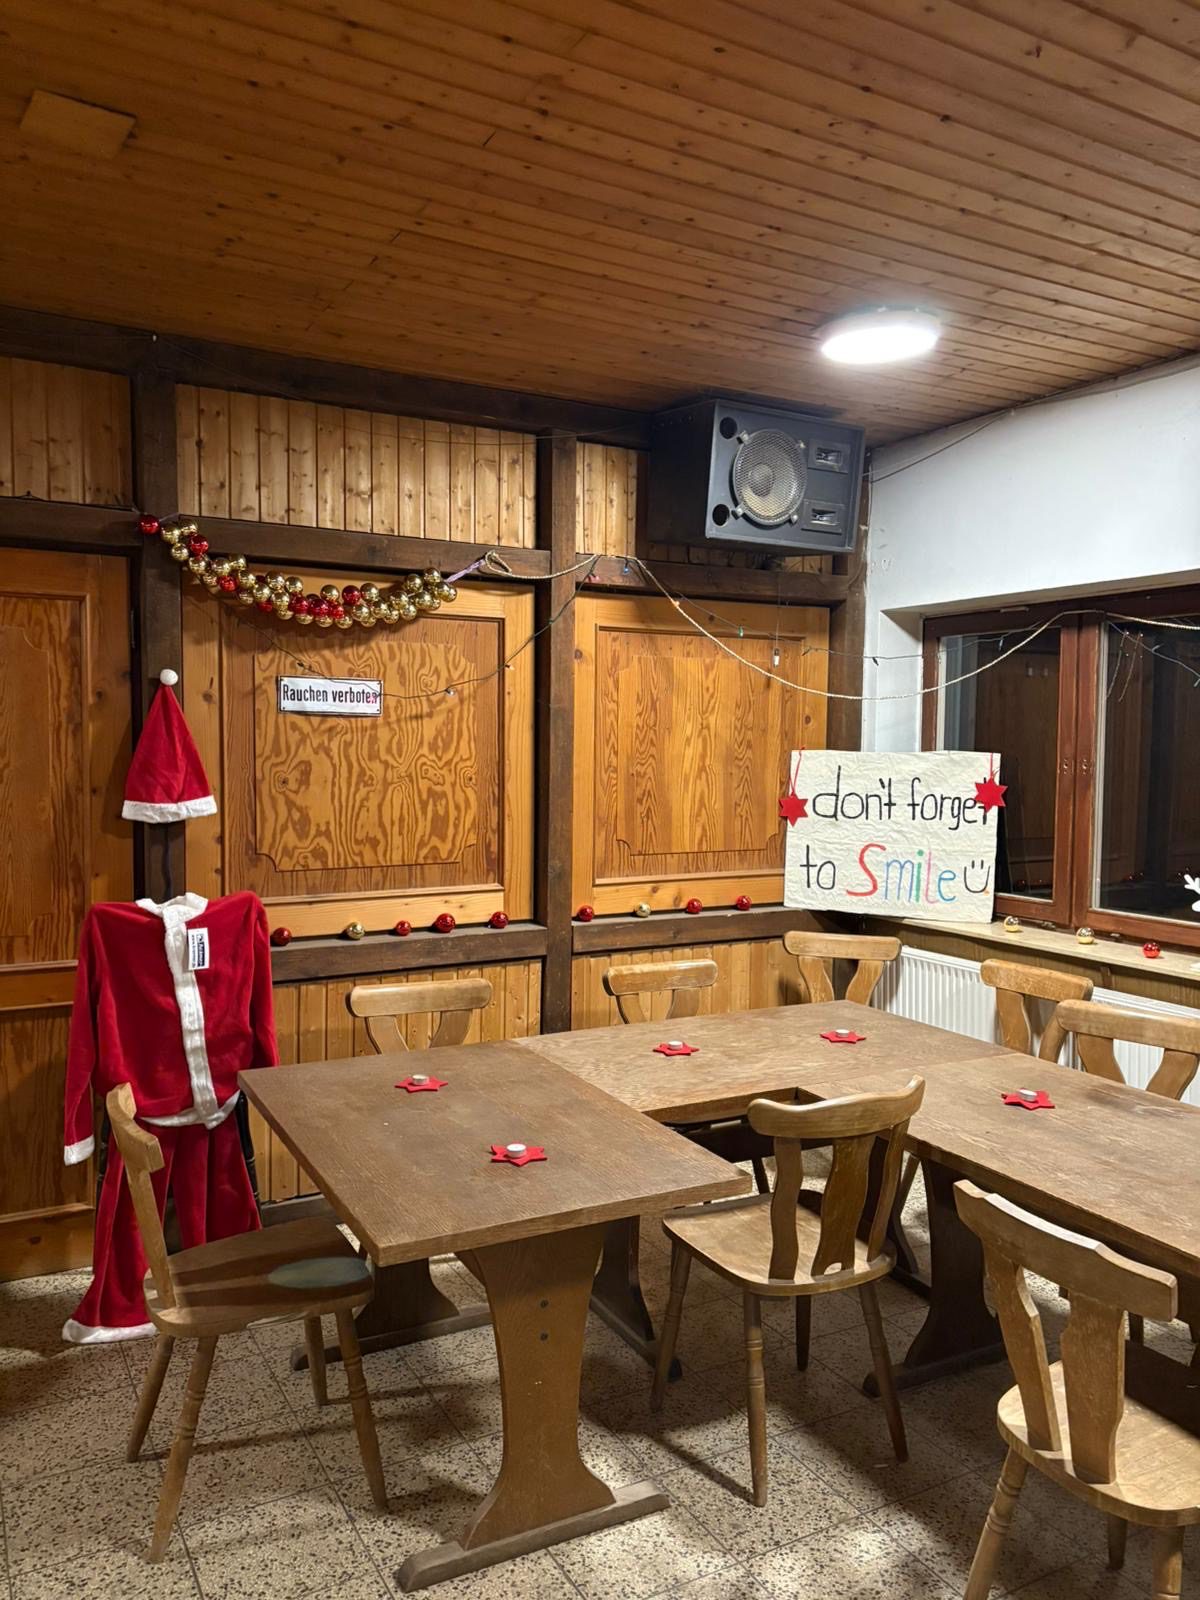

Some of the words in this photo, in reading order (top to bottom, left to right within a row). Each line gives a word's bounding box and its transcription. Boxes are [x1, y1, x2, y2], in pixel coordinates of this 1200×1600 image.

[282, 684, 328, 702] Rauchen
[332, 687, 378, 704] verboten
[812, 765, 897, 821] don't
[799, 844, 836, 890] to
[846, 843, 957, 904] Smile
